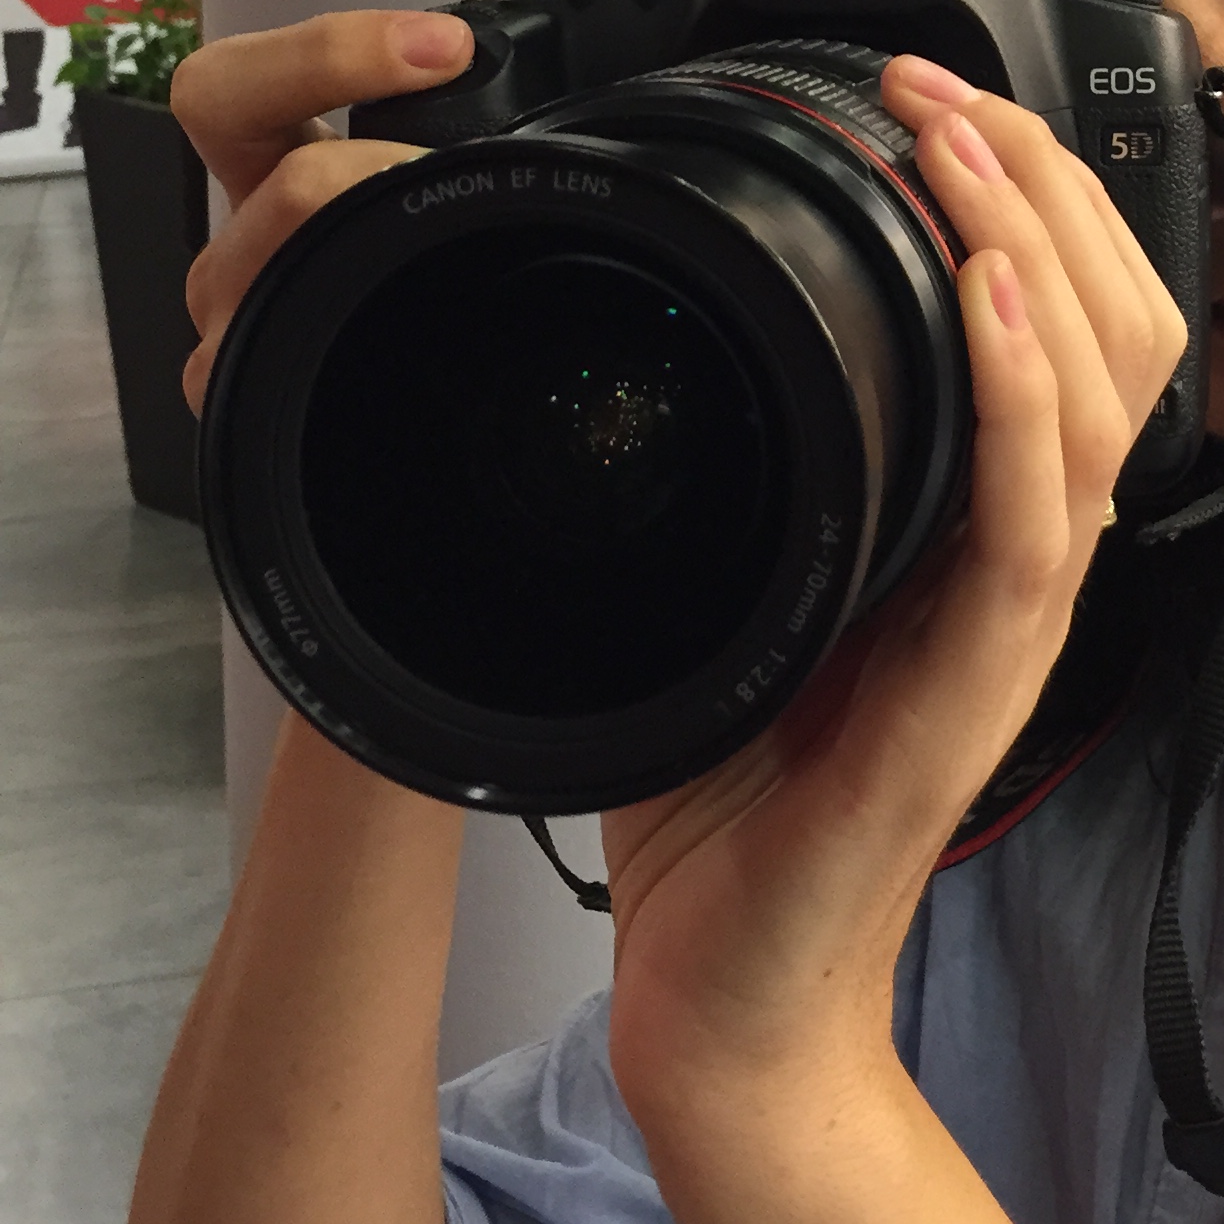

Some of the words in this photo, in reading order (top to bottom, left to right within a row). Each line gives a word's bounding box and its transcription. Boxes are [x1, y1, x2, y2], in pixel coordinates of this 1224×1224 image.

[1089, 67, 1156, 94] EOS
[1110, 132, 1153, 160] 5D
[402, 171, 494, 214] CANON
[511, 167, 537, 189] EF
[553, 170, 612, 198] LENS
[787, 512, 842, 632] 24-70mm
